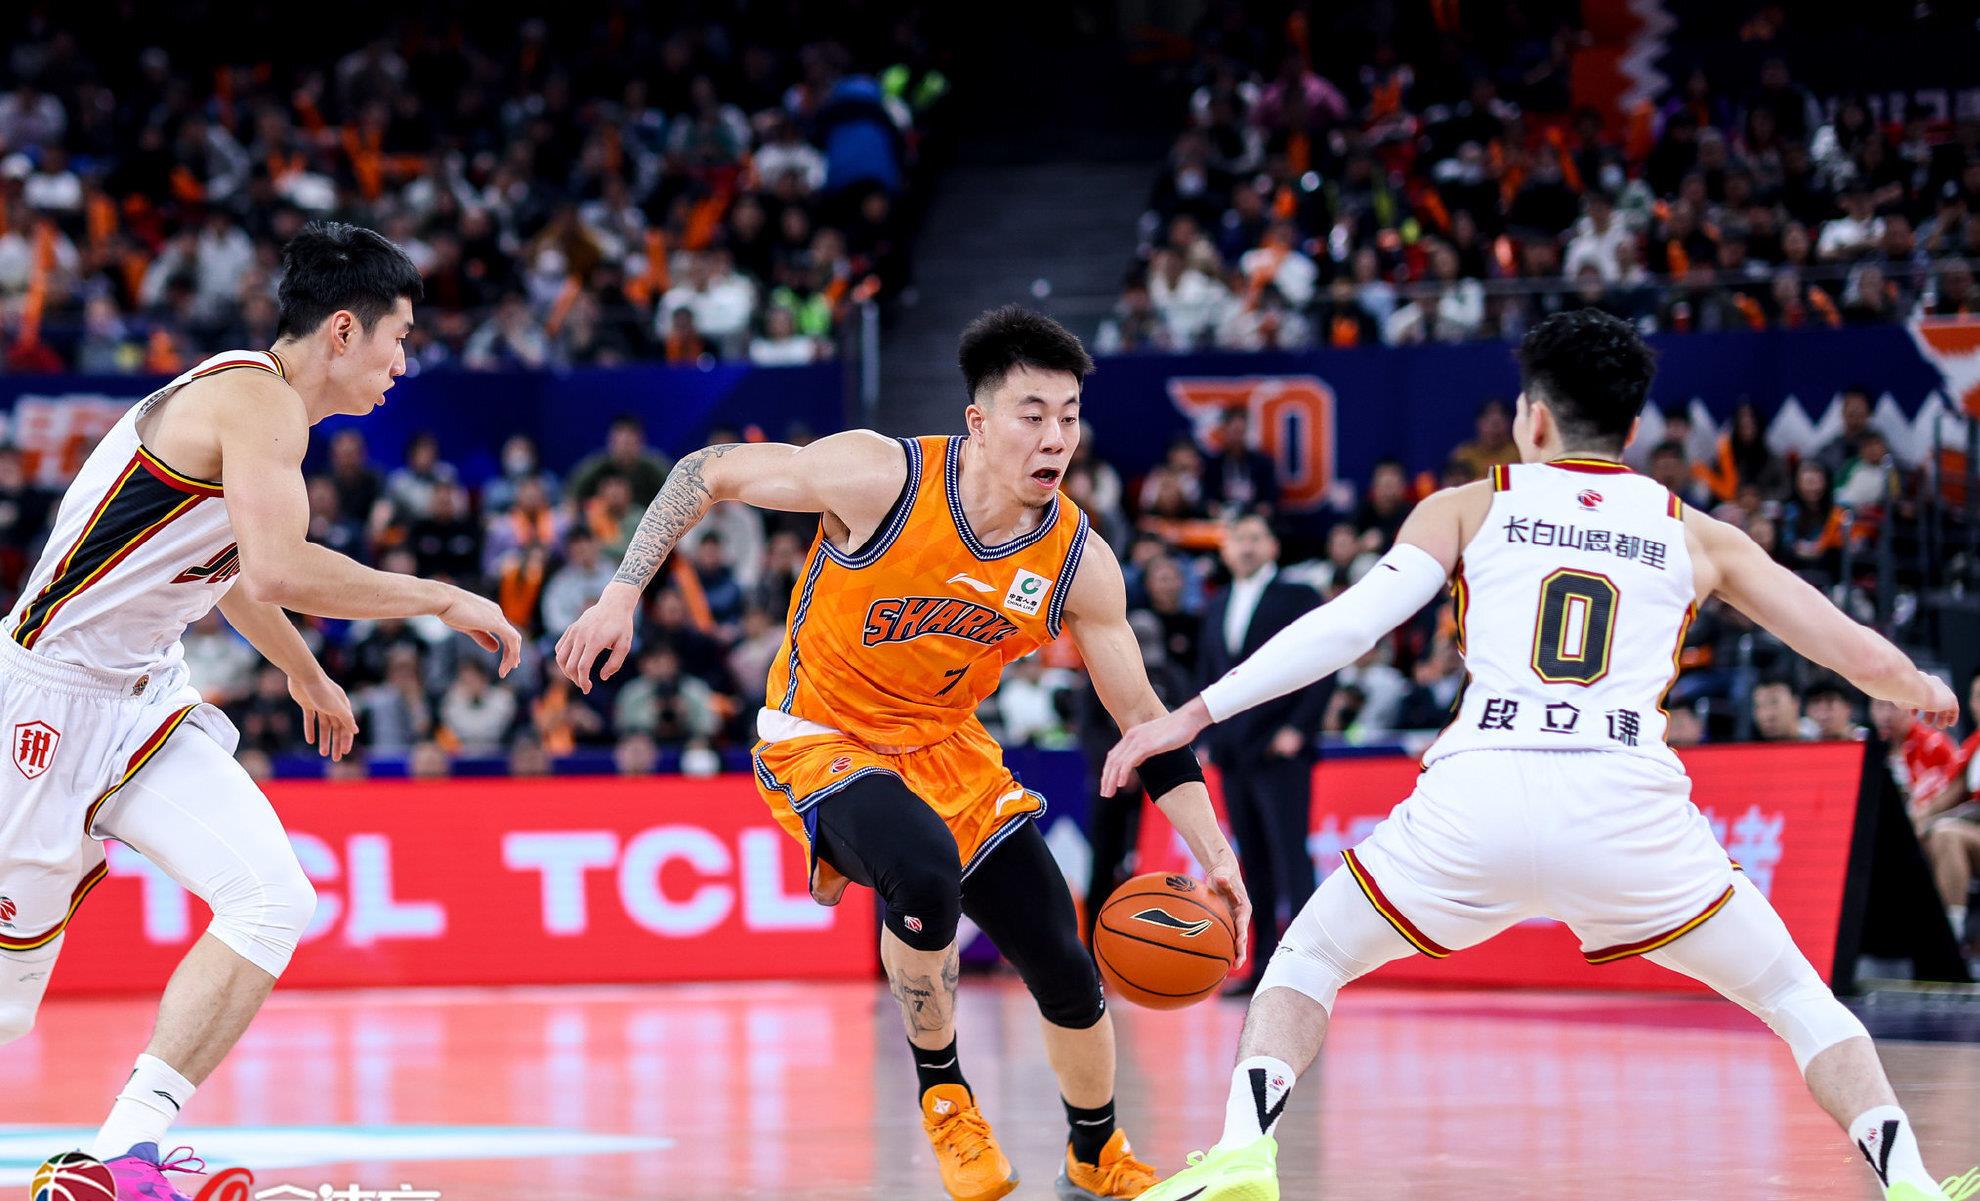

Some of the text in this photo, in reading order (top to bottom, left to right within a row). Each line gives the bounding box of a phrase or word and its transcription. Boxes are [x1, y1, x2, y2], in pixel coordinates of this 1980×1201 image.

[1503, 515, 1667, 570] 长白山恩都里
[862, 596, 1020, 648] SHARK
[1007, 599, 1035, 612] CHINA LIFE
[1530, 567, 1621, 687] 0
[933, 663, 971, 697] 7
[1478, 698, 1641, 747] 段立谦
[502, 823, 836, 939] TCL
[914, 1000, 924, 1013] 7
